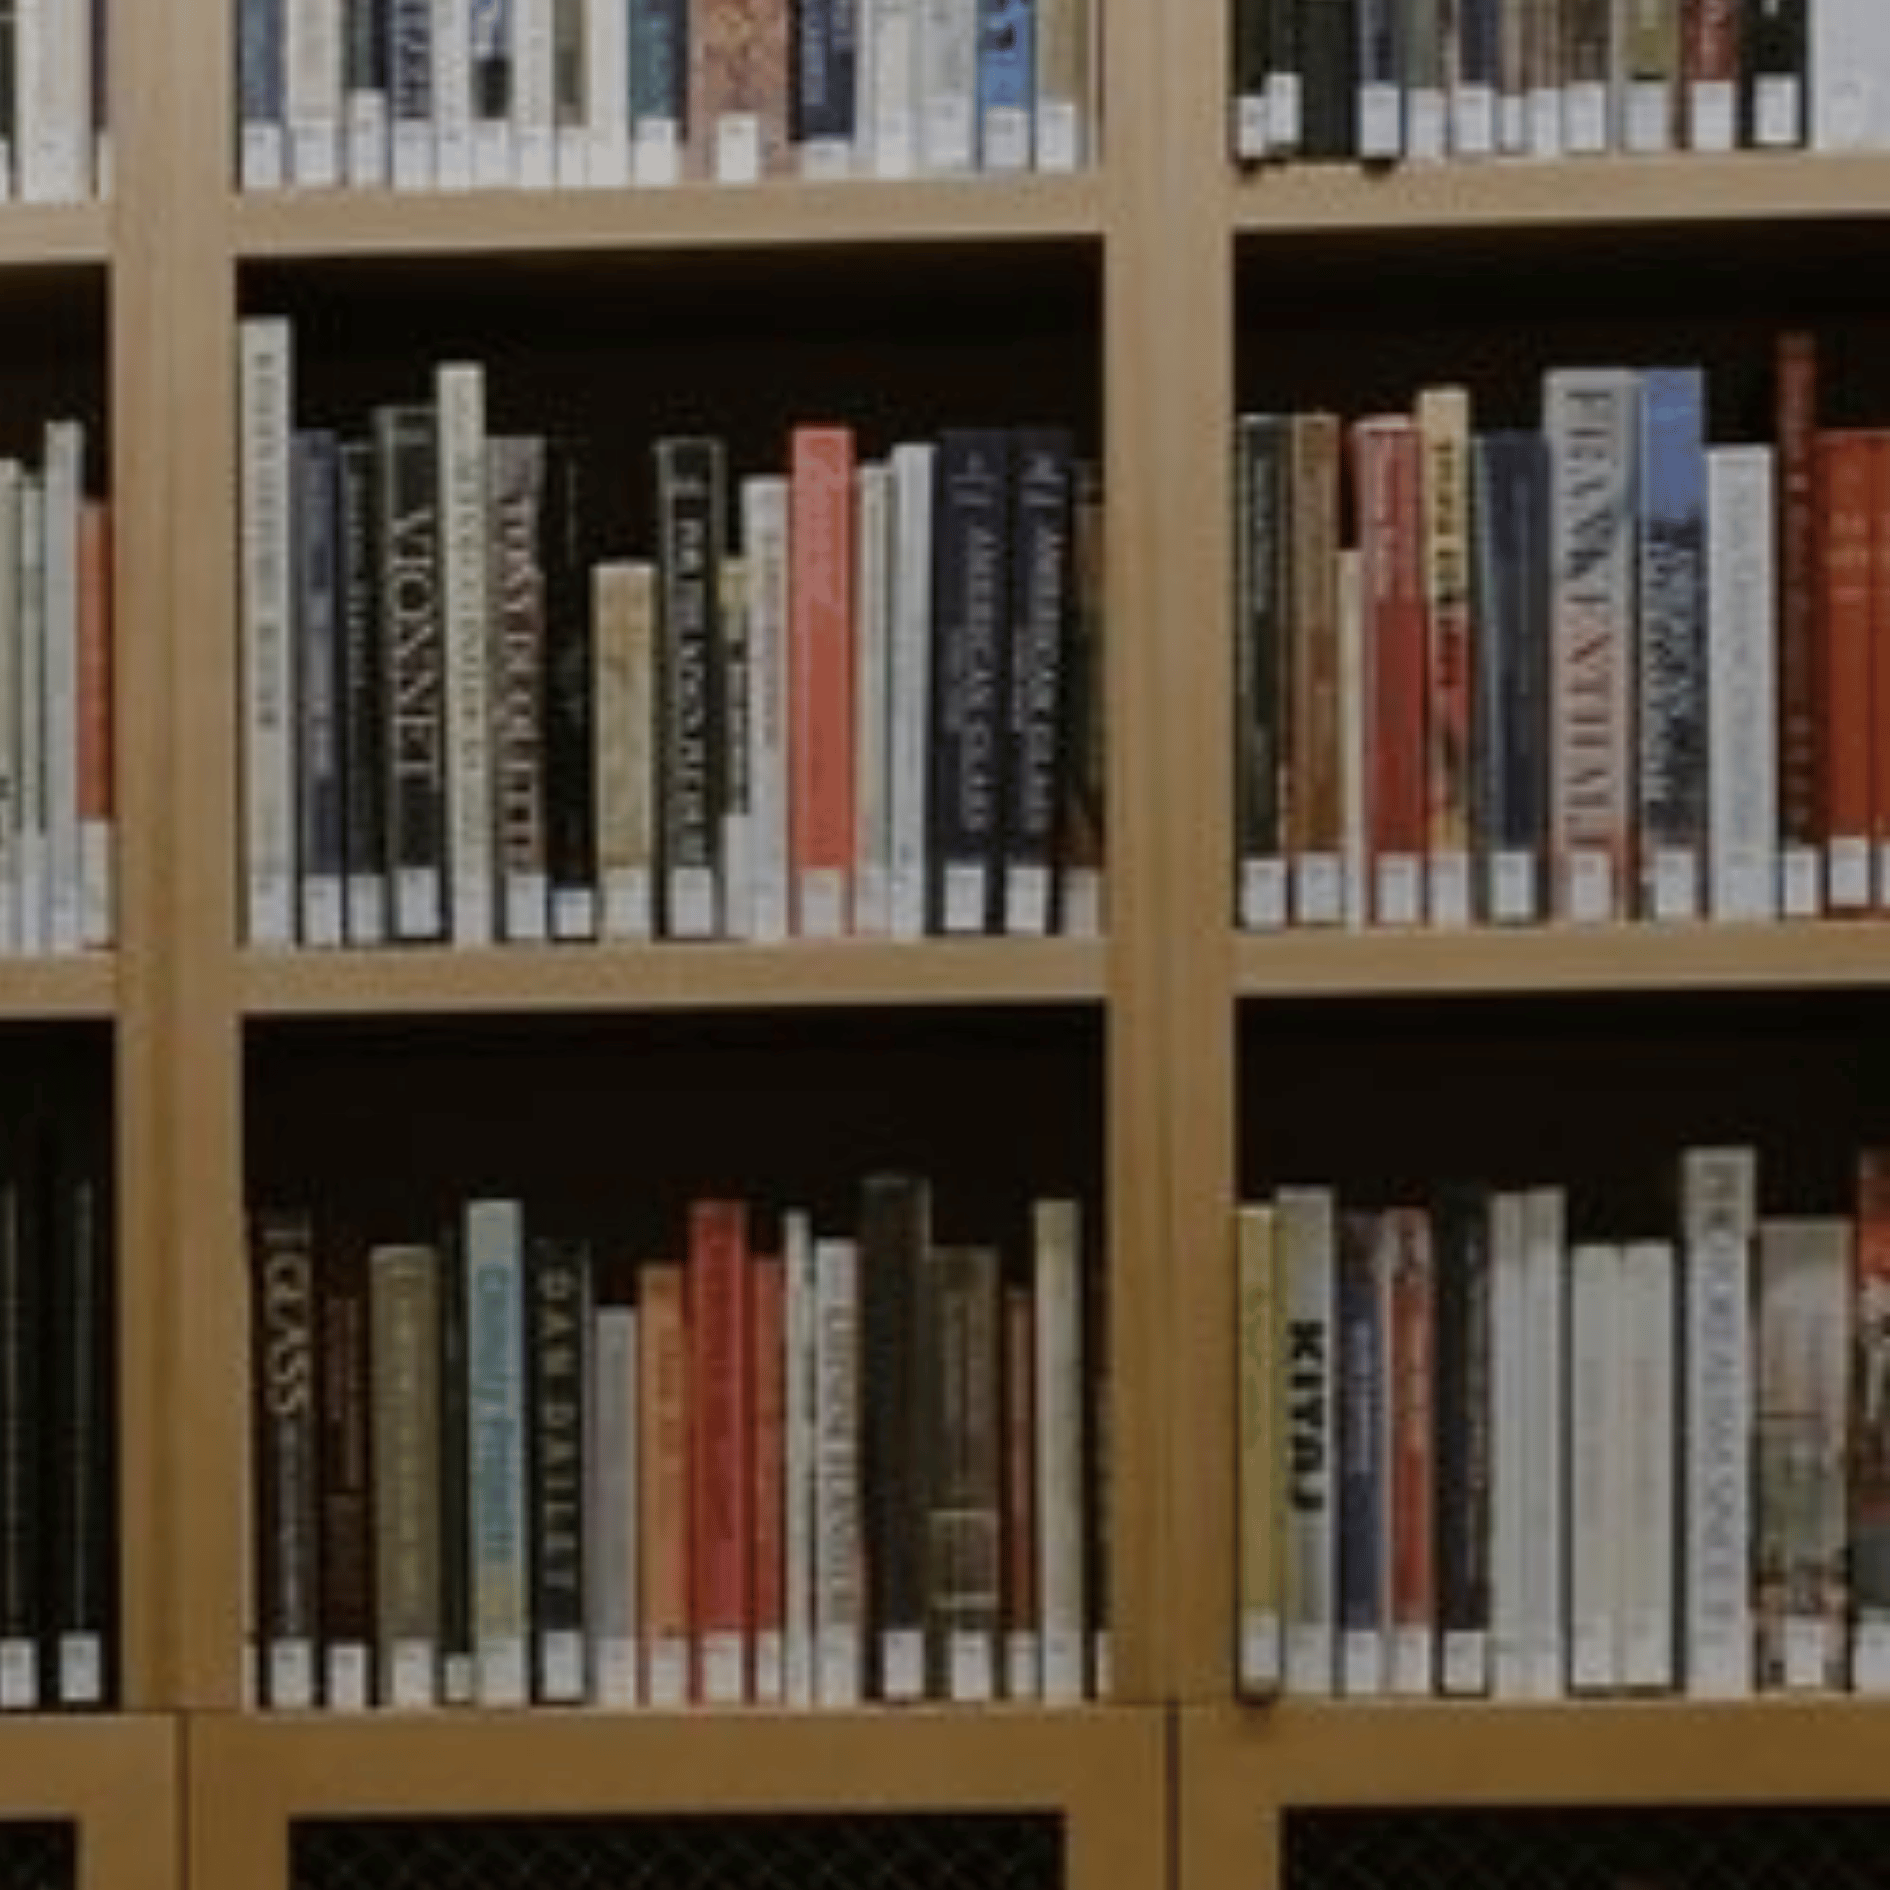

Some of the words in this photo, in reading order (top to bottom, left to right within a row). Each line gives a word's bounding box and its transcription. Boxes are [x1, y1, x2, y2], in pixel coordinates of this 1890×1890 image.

[388, 507, 436, 791] VIONNET
[265, 1253, 313, 1416] GLASS
[541, 1269, 577, 1377] DAN
[1286, 1322, 1327, 1514] KITAJ
